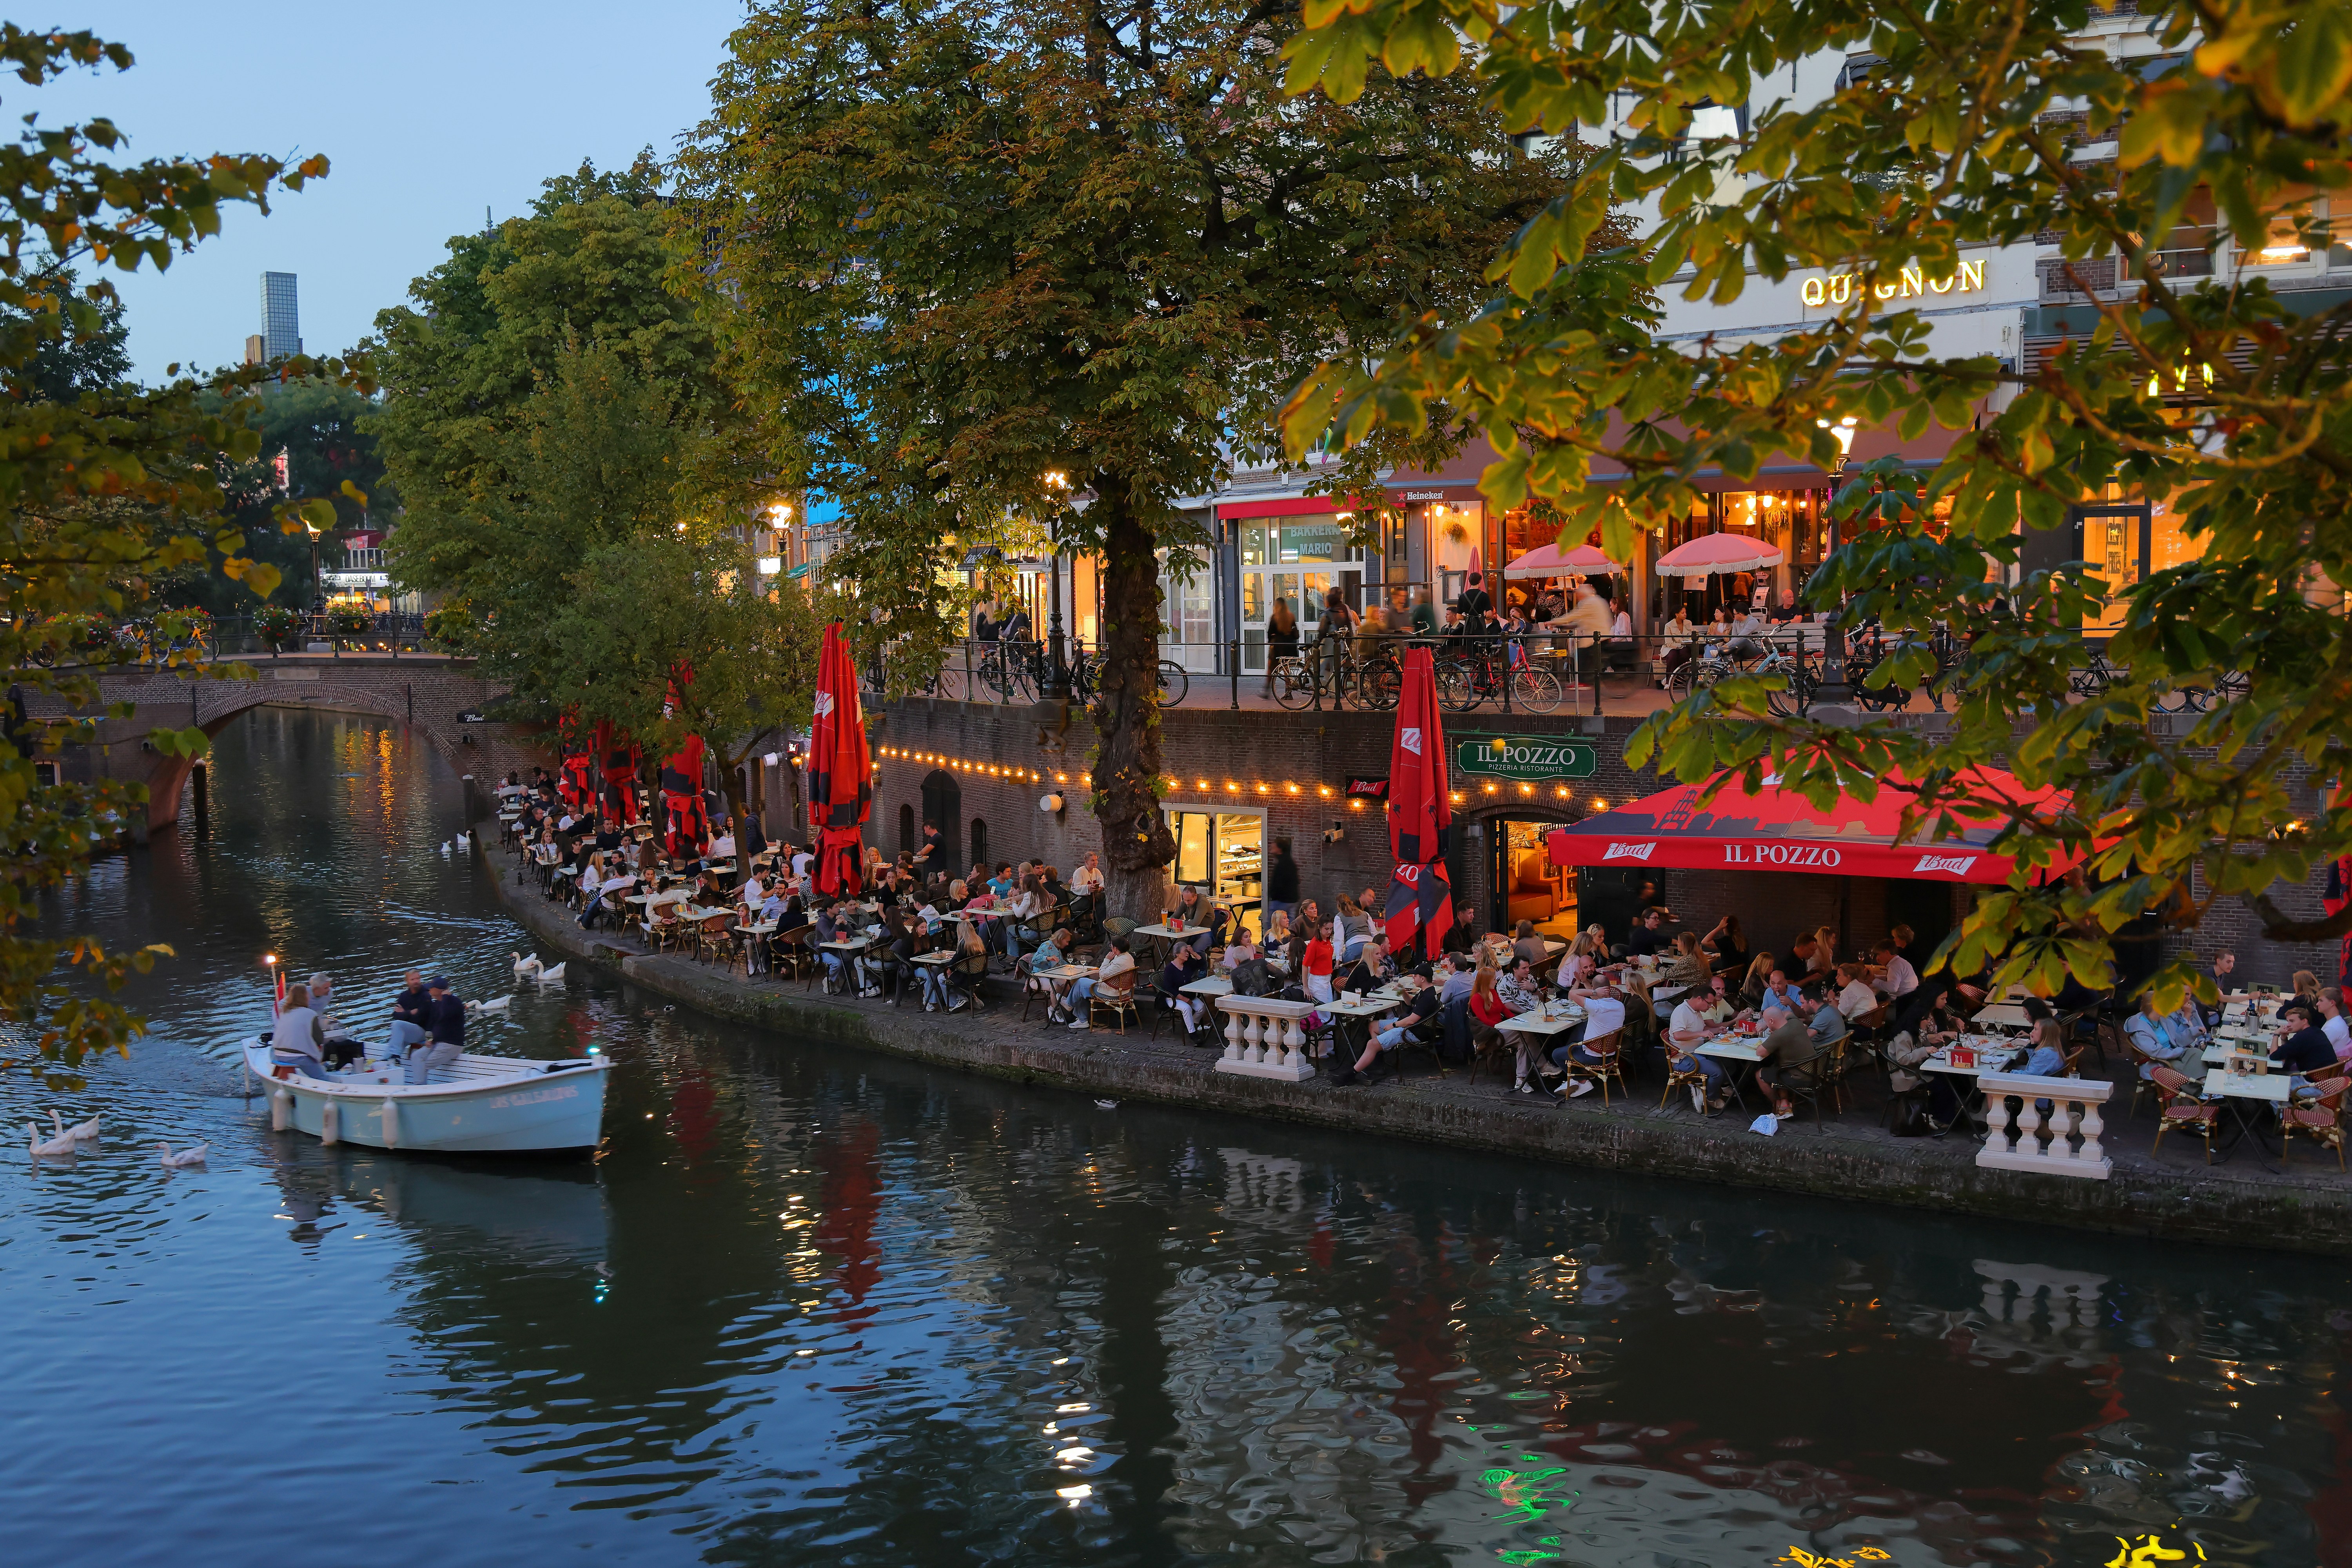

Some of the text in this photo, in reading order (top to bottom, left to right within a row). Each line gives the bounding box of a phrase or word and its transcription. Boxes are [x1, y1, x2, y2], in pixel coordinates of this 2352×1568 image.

[1407, 491, 1443, 500] Heineken
[1300, 543, 1332, 554] MARIO
[1477, 745, 1576, 765] IL POZZO
[1355, 782, 1377, 791] Bud
[1609, 843, 1647, 856] Bud
[1724, 844, 1841, 867] IL POZZO
[1921, 855, 1961, 870] Bud
